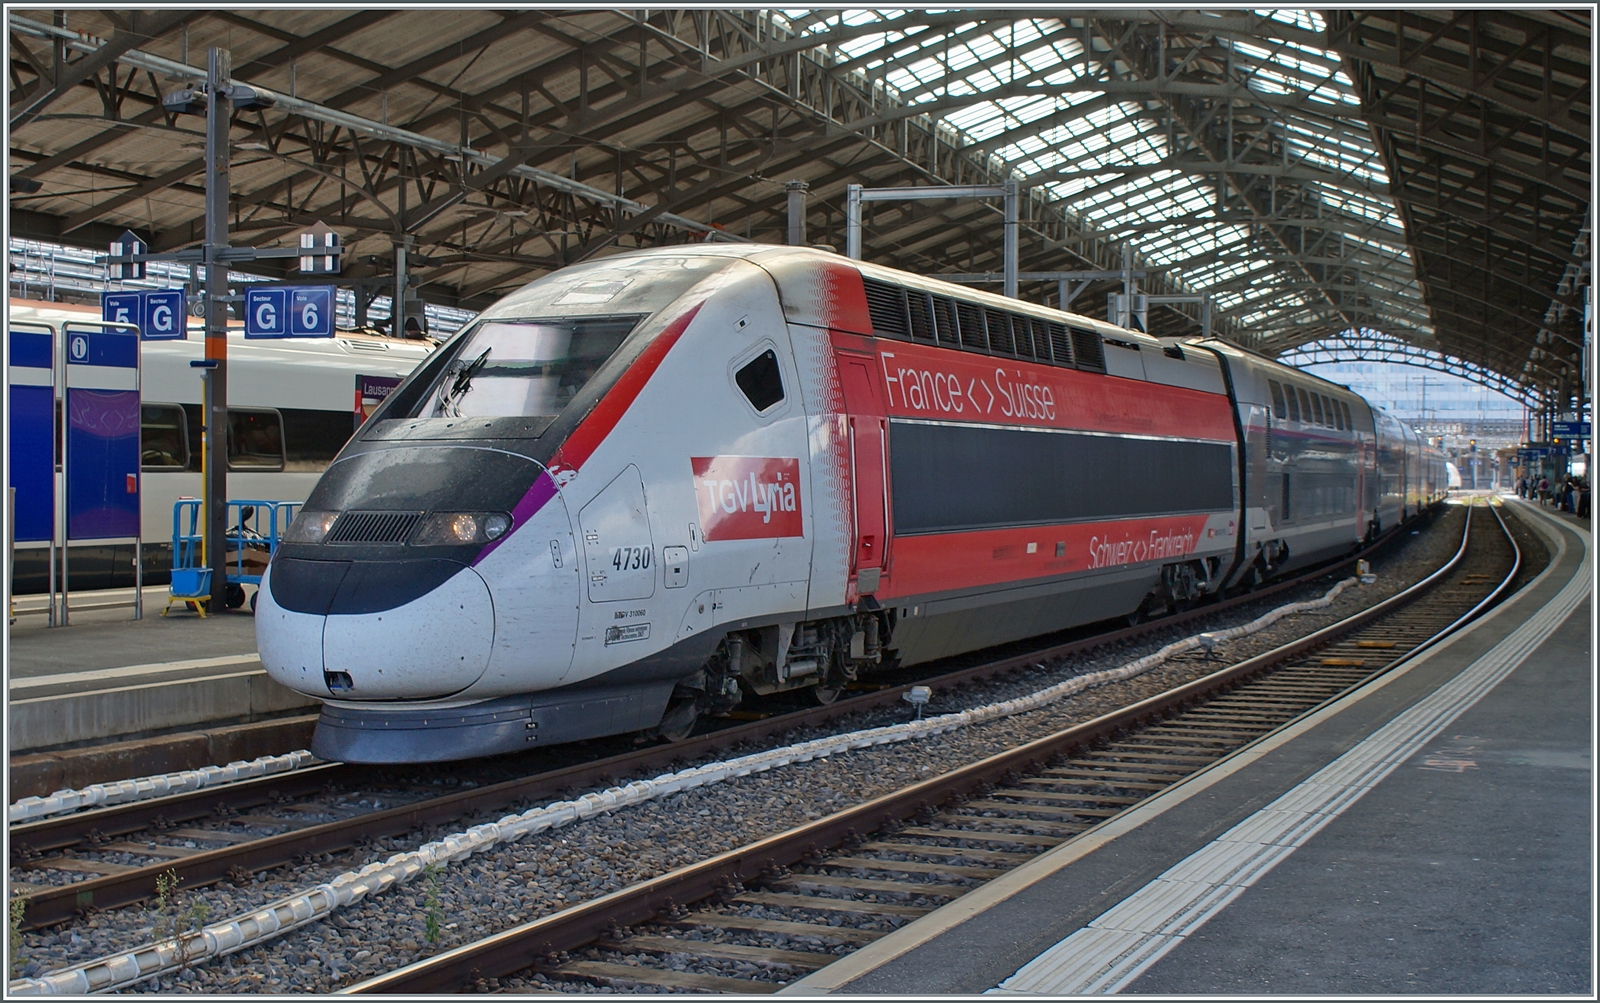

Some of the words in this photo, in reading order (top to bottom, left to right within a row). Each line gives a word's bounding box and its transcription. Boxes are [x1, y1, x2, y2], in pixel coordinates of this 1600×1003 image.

[115, 308, 129, 333] 5
[153, 305, 172, 331] G
[256, 303, 276, 330] G
[302, 303, 318, 330] 6
[881, 351, 963, 413] France
[995, 368, 1055, 420] Suisse
[703, 479, 748, 514] TGV
[750, 472, 797, 524] Lyria
[612, 546, 651, 571] 4730
[1087, 532, 1133, 570] Schweiz
[1148, 526, 1194, 560] Frankreich
